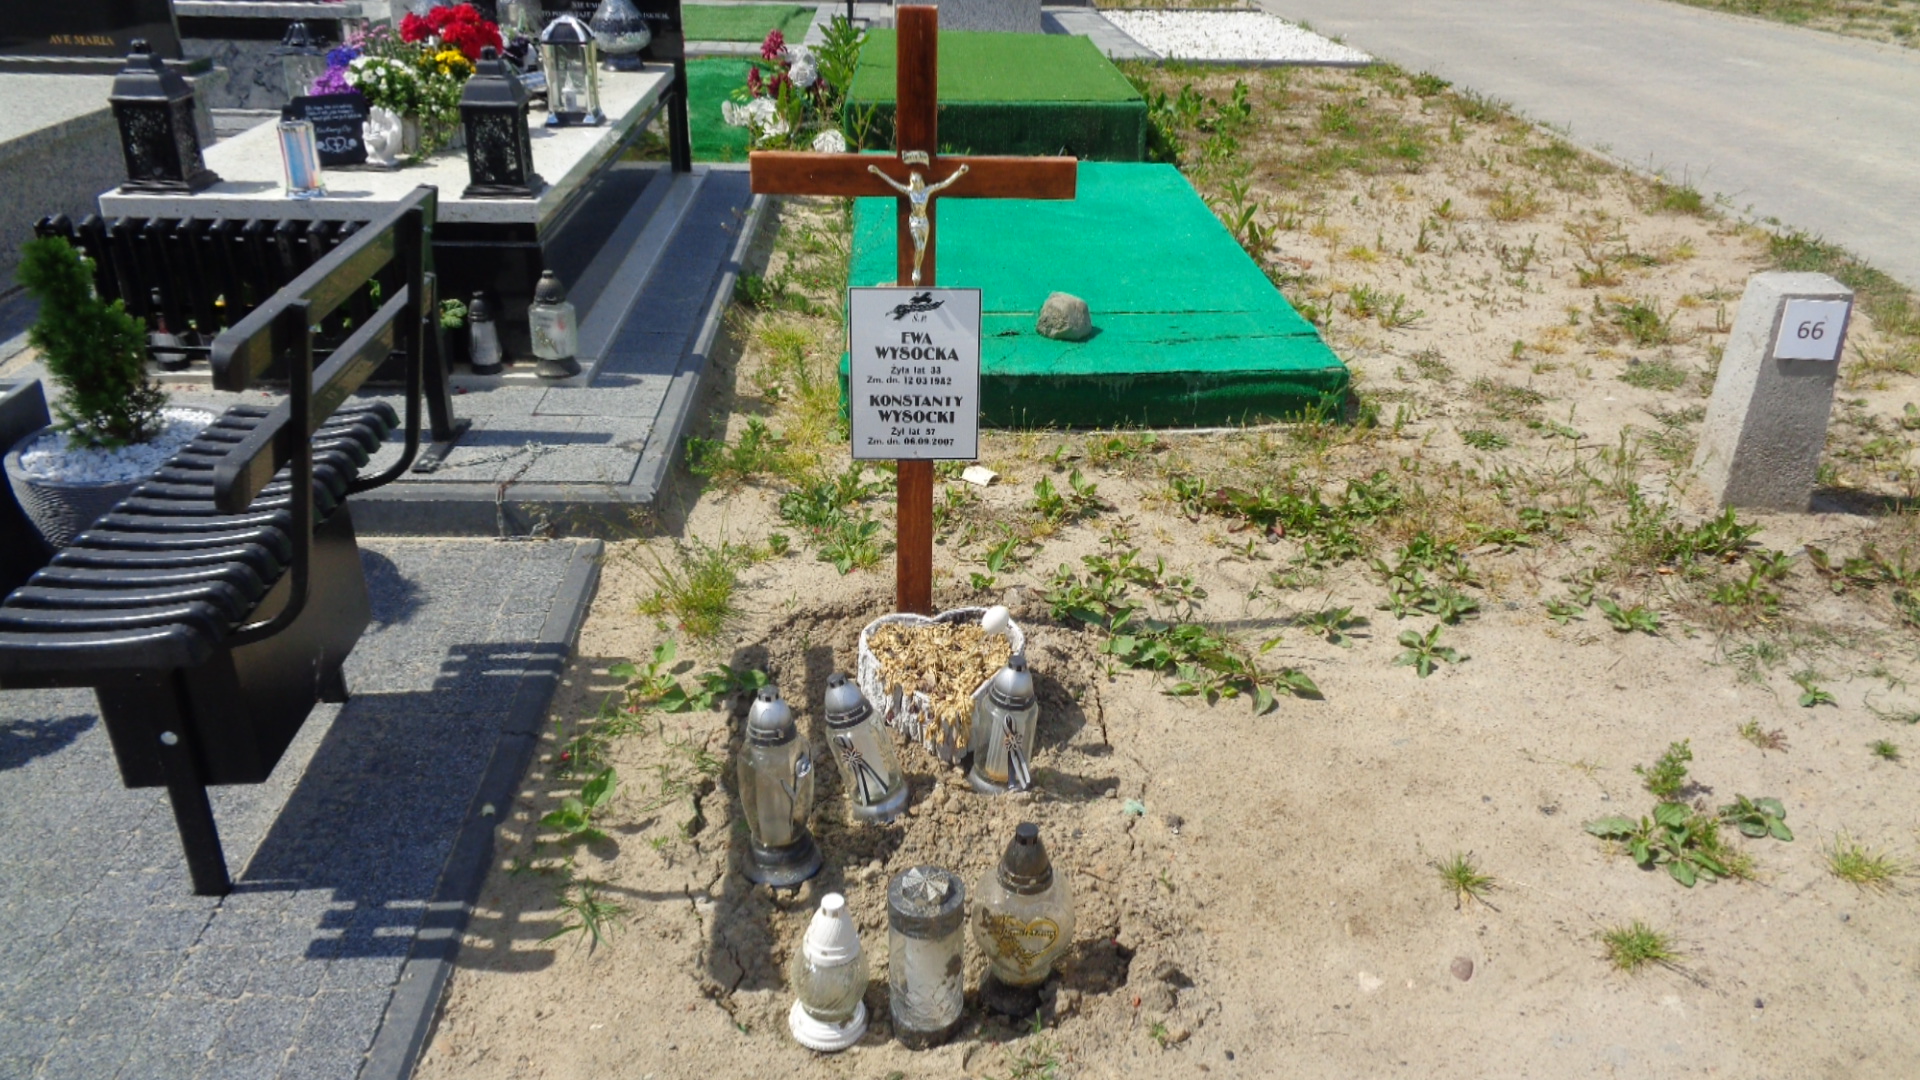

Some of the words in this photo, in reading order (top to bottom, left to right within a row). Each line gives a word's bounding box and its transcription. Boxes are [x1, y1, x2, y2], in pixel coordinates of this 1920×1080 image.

[49, 34, 72, 45] AVE
[73, 34, 115, 46] MARIA
[1797, 321, 1825, 340] 66
[901, 331, 932, 345] EWA
[875, 346, 959, 361] WYSOCKA
[914, 366, 926, 375] lat
[869, 394, 963, 407] KONSTANTY
[878, 409, 955, 424] WYSOCKI
[908, 427, 920, 436] lat
[925, 428, 936, 436] 57
